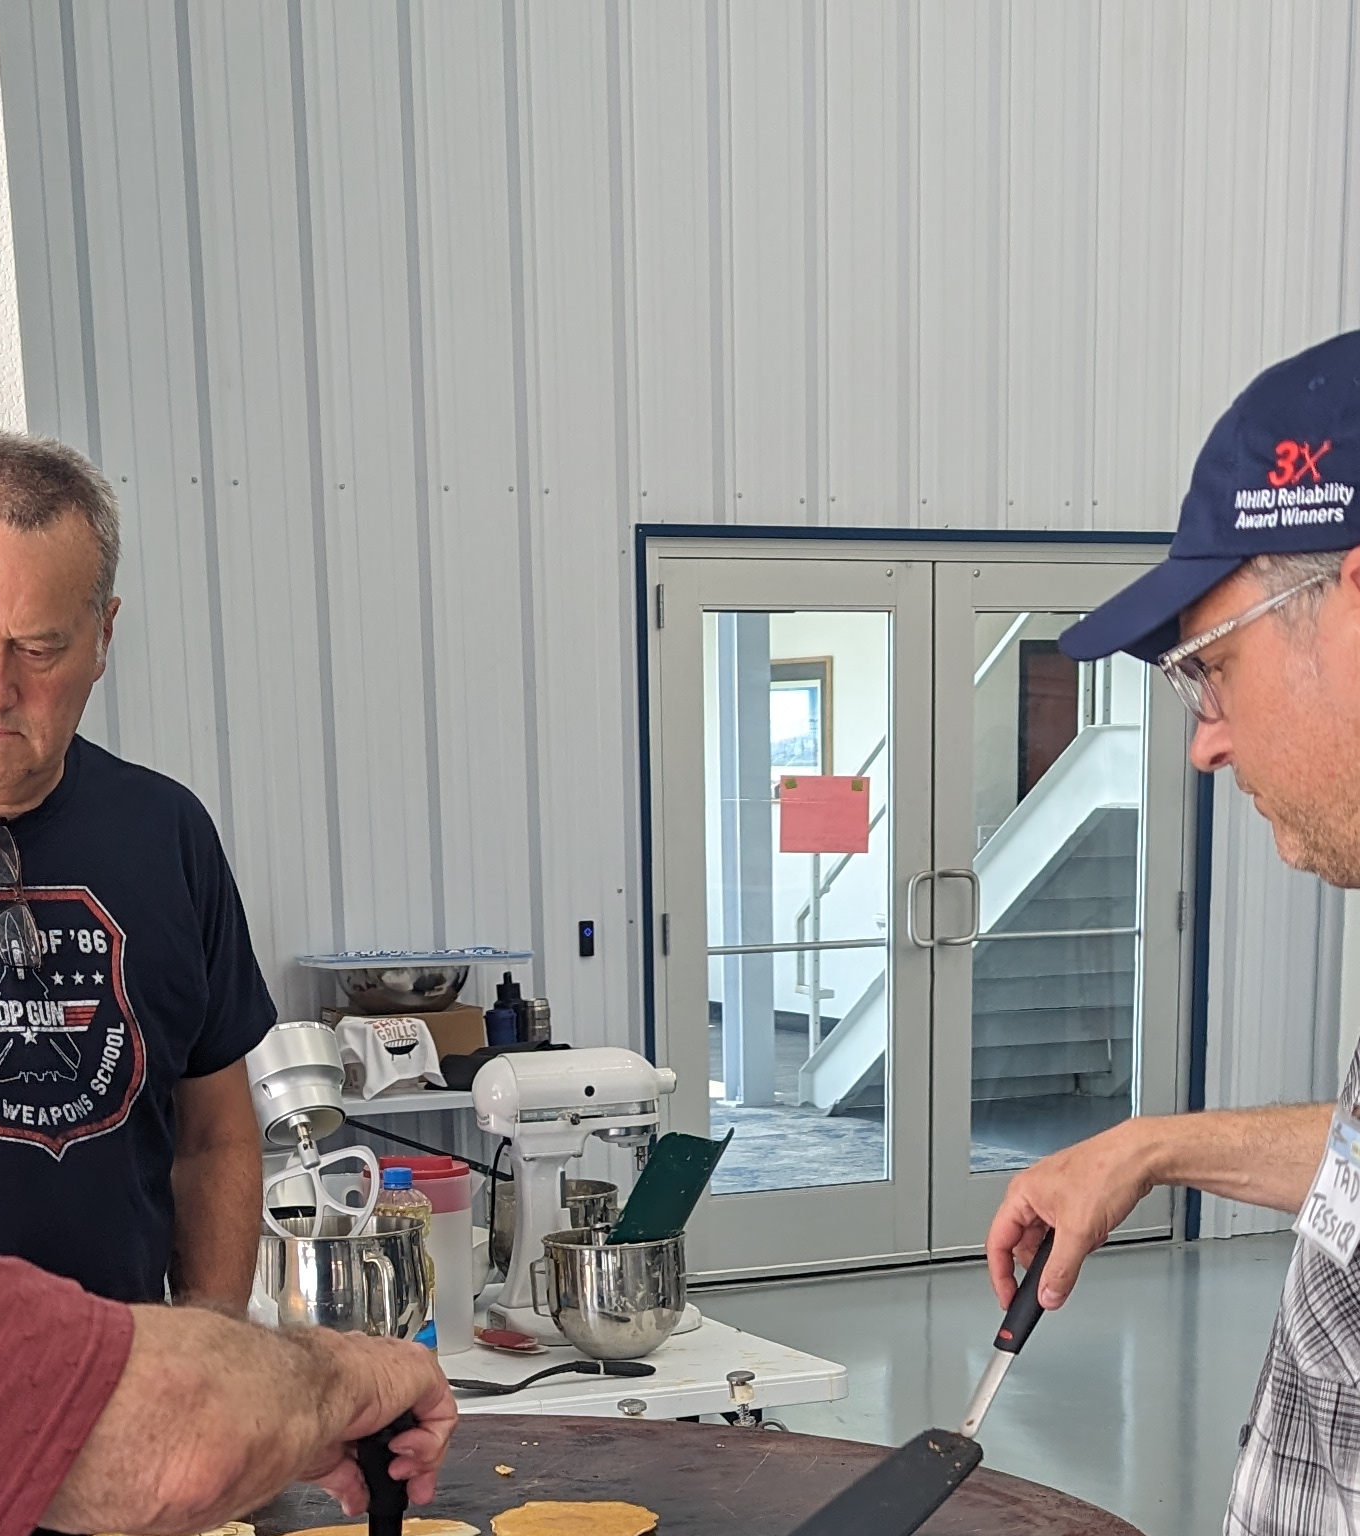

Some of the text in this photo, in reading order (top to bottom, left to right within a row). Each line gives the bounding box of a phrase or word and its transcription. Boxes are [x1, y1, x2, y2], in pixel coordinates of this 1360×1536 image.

[1267, 439, 1332, 487] 3X
[1235, 481, 1354, 509] MHIRJ Reliability
[1235, 506, 1344, 529] Award Winners
[26, 1000, 66, 1026] GUN
[376, 1023, 418, 1041] GRILLS
[1, 1092, 95, 1126] WEAPONS
[89, 1020, 125, 1096] SCHOOL
[1333, 1157, 1360, 1203] TAD
[1307, 1192, 1356, 1255] TESSIER
